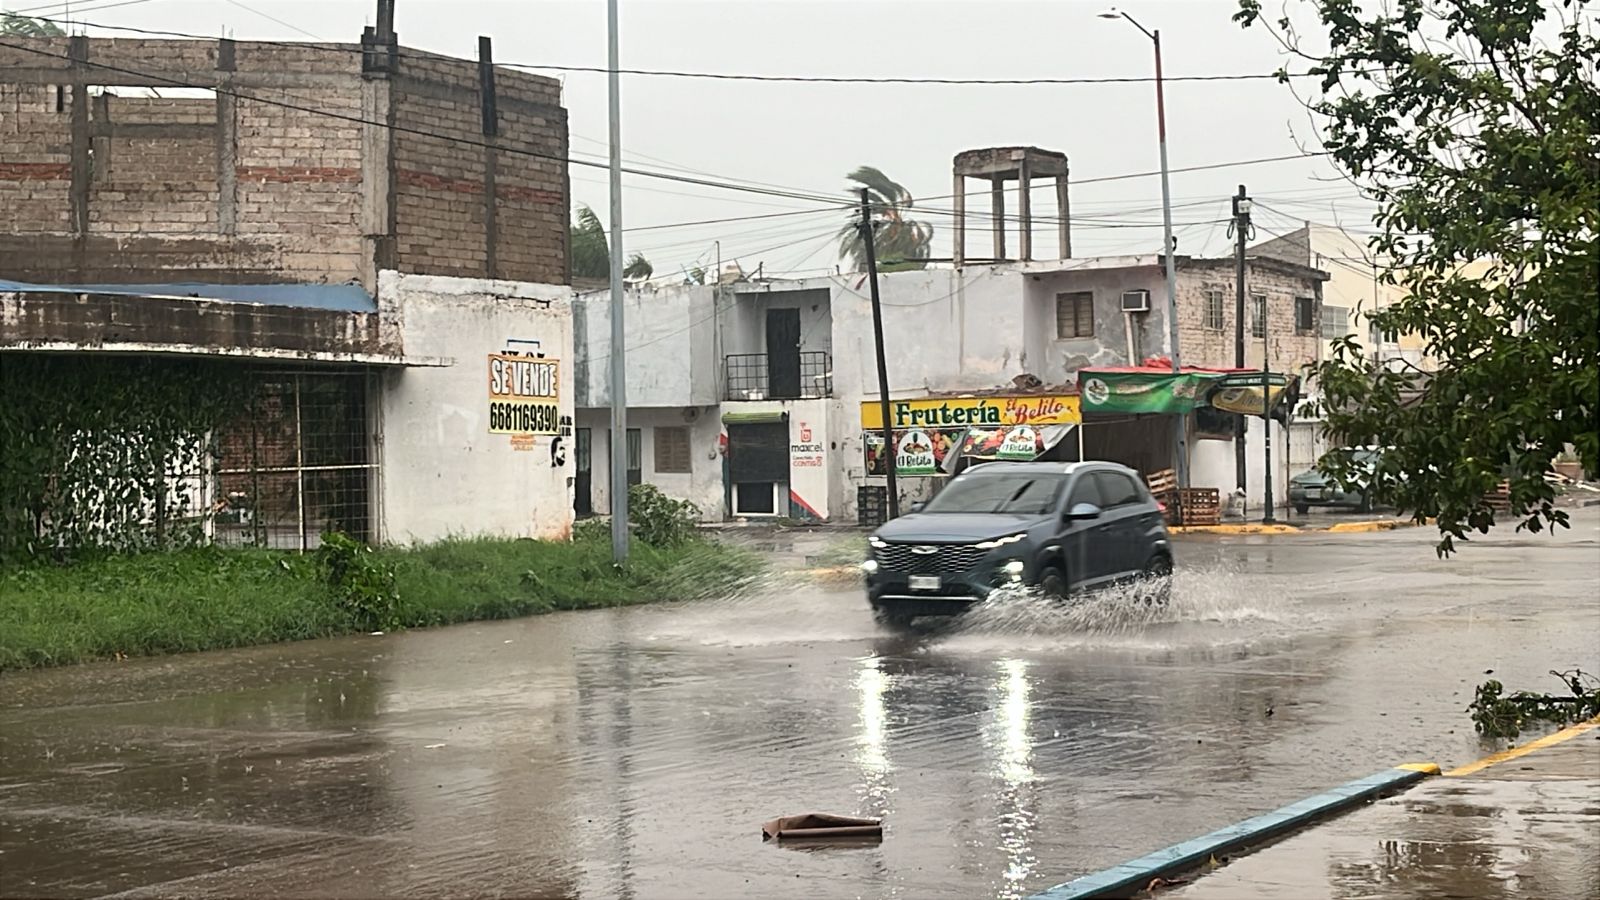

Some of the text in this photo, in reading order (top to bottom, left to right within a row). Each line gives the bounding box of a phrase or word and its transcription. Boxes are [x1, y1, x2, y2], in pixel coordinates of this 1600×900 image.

[492, 358, 558, 398] SE VENDE
[490, 402, 558, 432] 6681169390
[896, 399, 1001, 426] Frutería
[1006, 398, 1017, 412] El
